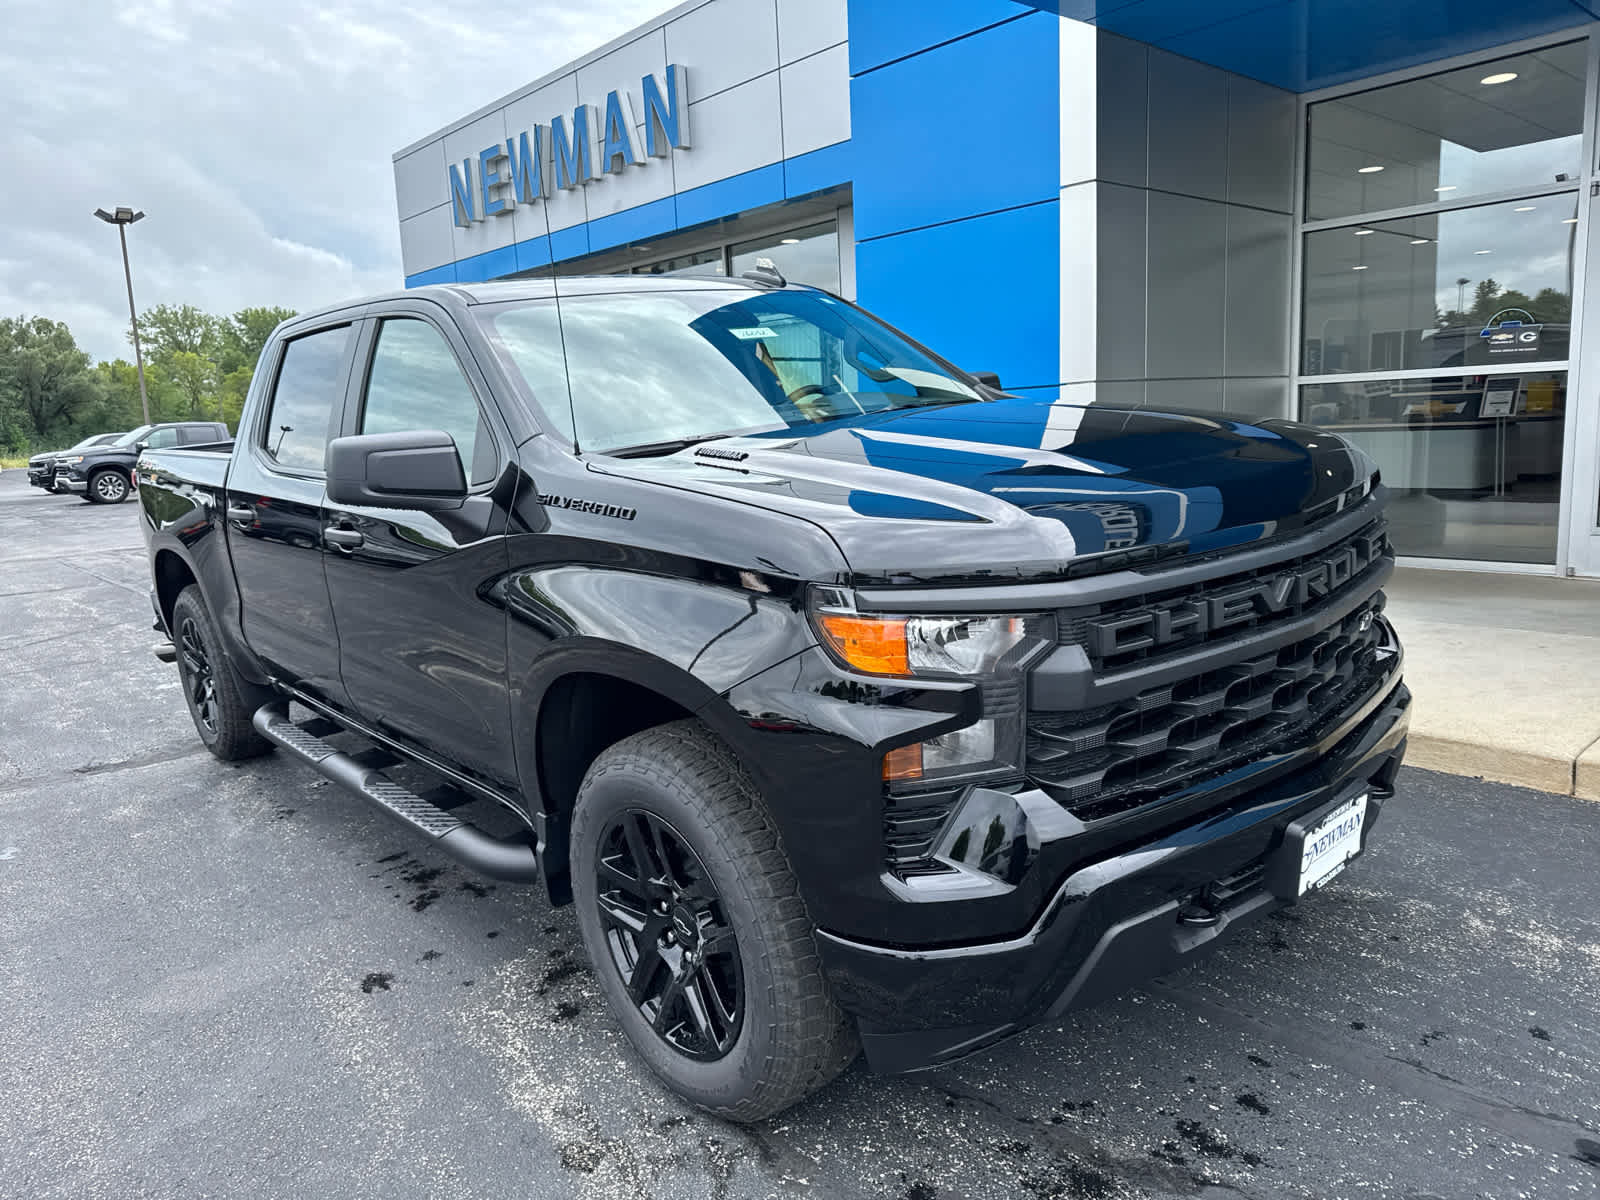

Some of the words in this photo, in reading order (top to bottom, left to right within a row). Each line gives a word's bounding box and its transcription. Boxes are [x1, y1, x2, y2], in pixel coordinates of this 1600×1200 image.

[449, 63, 690, 227] NEWMAN
[536, 492, 638, 521] SILVERADO
[1091, 528, 1389, 657] CHEVROLE
[1304, 811, 1363, 860] NEWMAN
